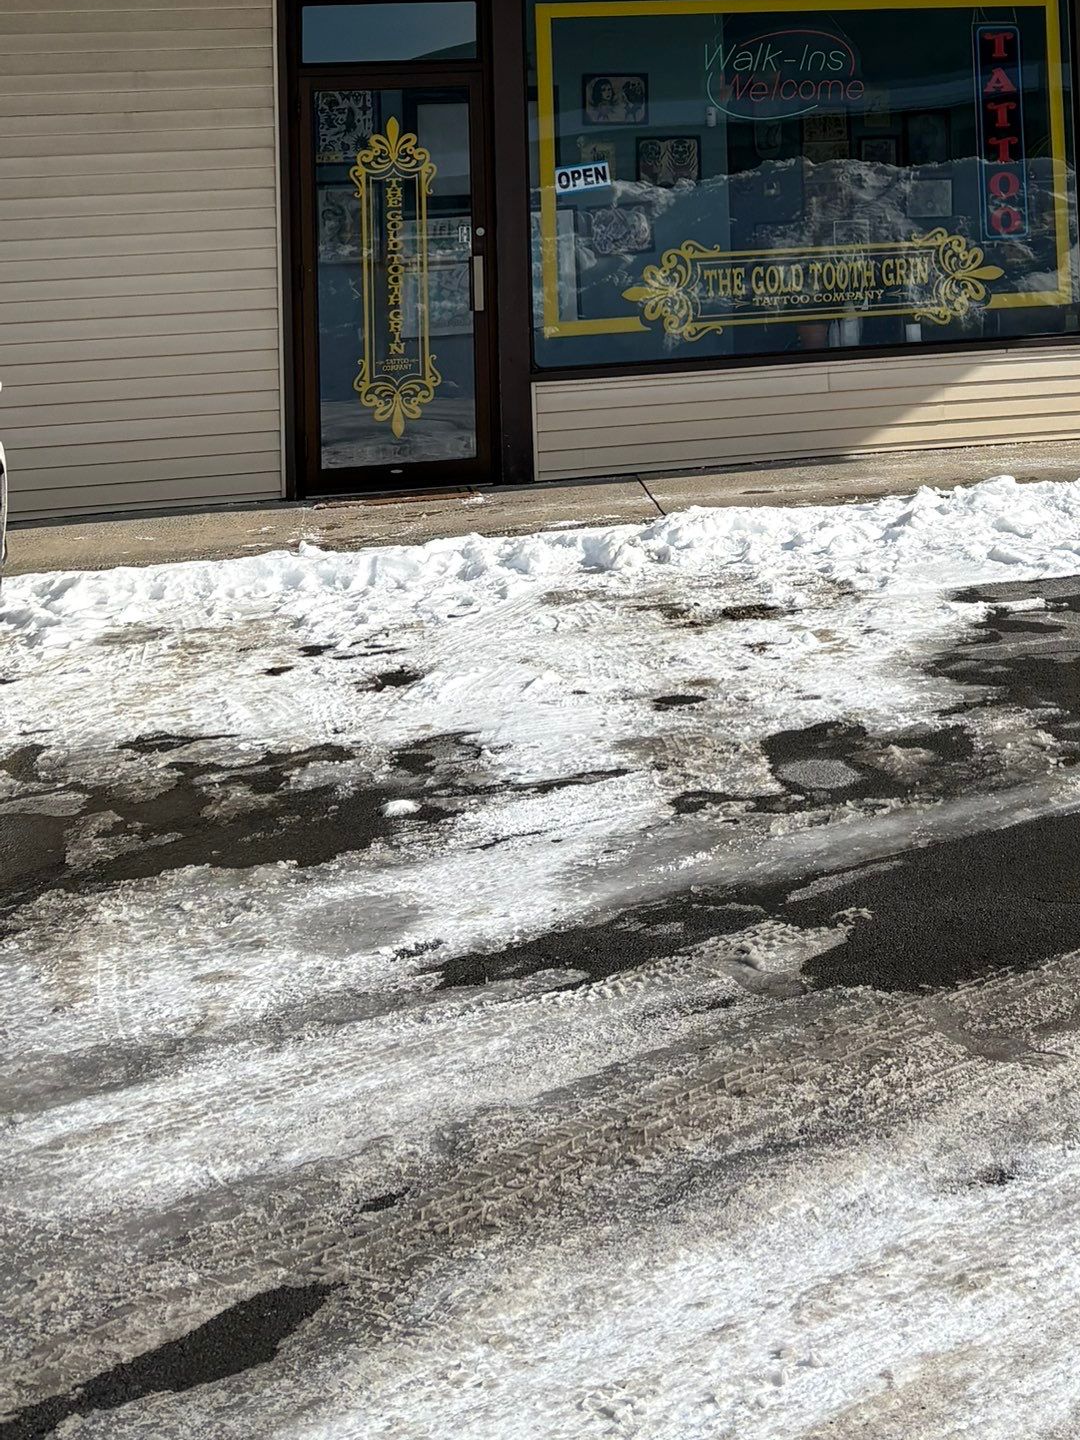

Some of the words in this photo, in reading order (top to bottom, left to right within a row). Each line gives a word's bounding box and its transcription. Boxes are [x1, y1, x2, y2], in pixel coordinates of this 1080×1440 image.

[704, 43, 847, 72] Walk-Ins
[719, 71, 865, 102] Welcome
[983, 32, 1022, 234] TATTOO
[558, 165, 608, 189] OPEN
[385, 178, 403, 208] THE
[386, 210, 404, 251] GOLD
[704, 267, 746, 298] THE
[751, 263, 804, 295] GOLD
[809, 260, 876, 291] TOOTH
[881, 256, 930, 287] GRIN
[752, 292, 811, 307] TATTOO
[813, 289, 885, 304] COMPANY
[388, 309, 406, 355] GRIN
